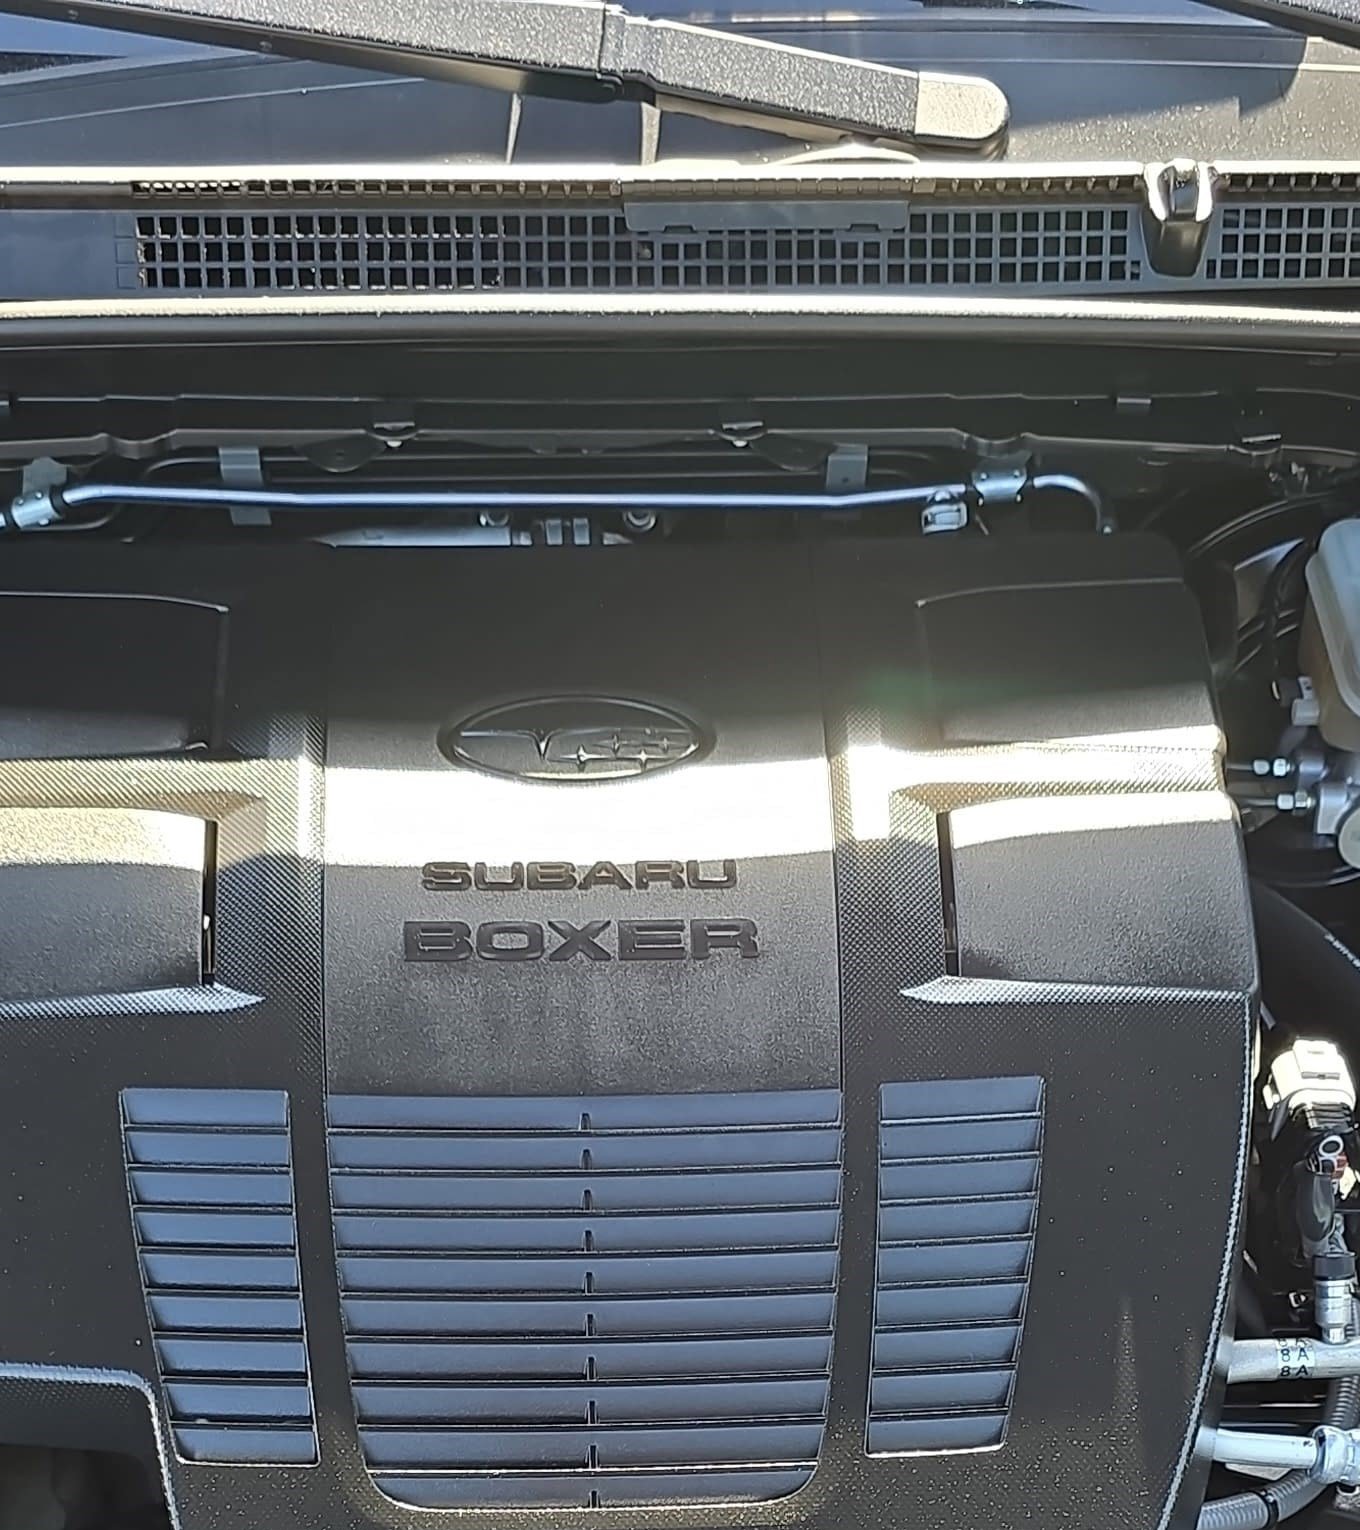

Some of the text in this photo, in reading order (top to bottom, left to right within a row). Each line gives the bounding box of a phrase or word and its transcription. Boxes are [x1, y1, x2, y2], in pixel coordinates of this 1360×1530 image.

[421, 859, 738, 891] SUBARU
[403, 917, 760, 962] BOXER
[1297, 1348, 1309, 1361] A
[1296, 1364, 1308, 1376] A
